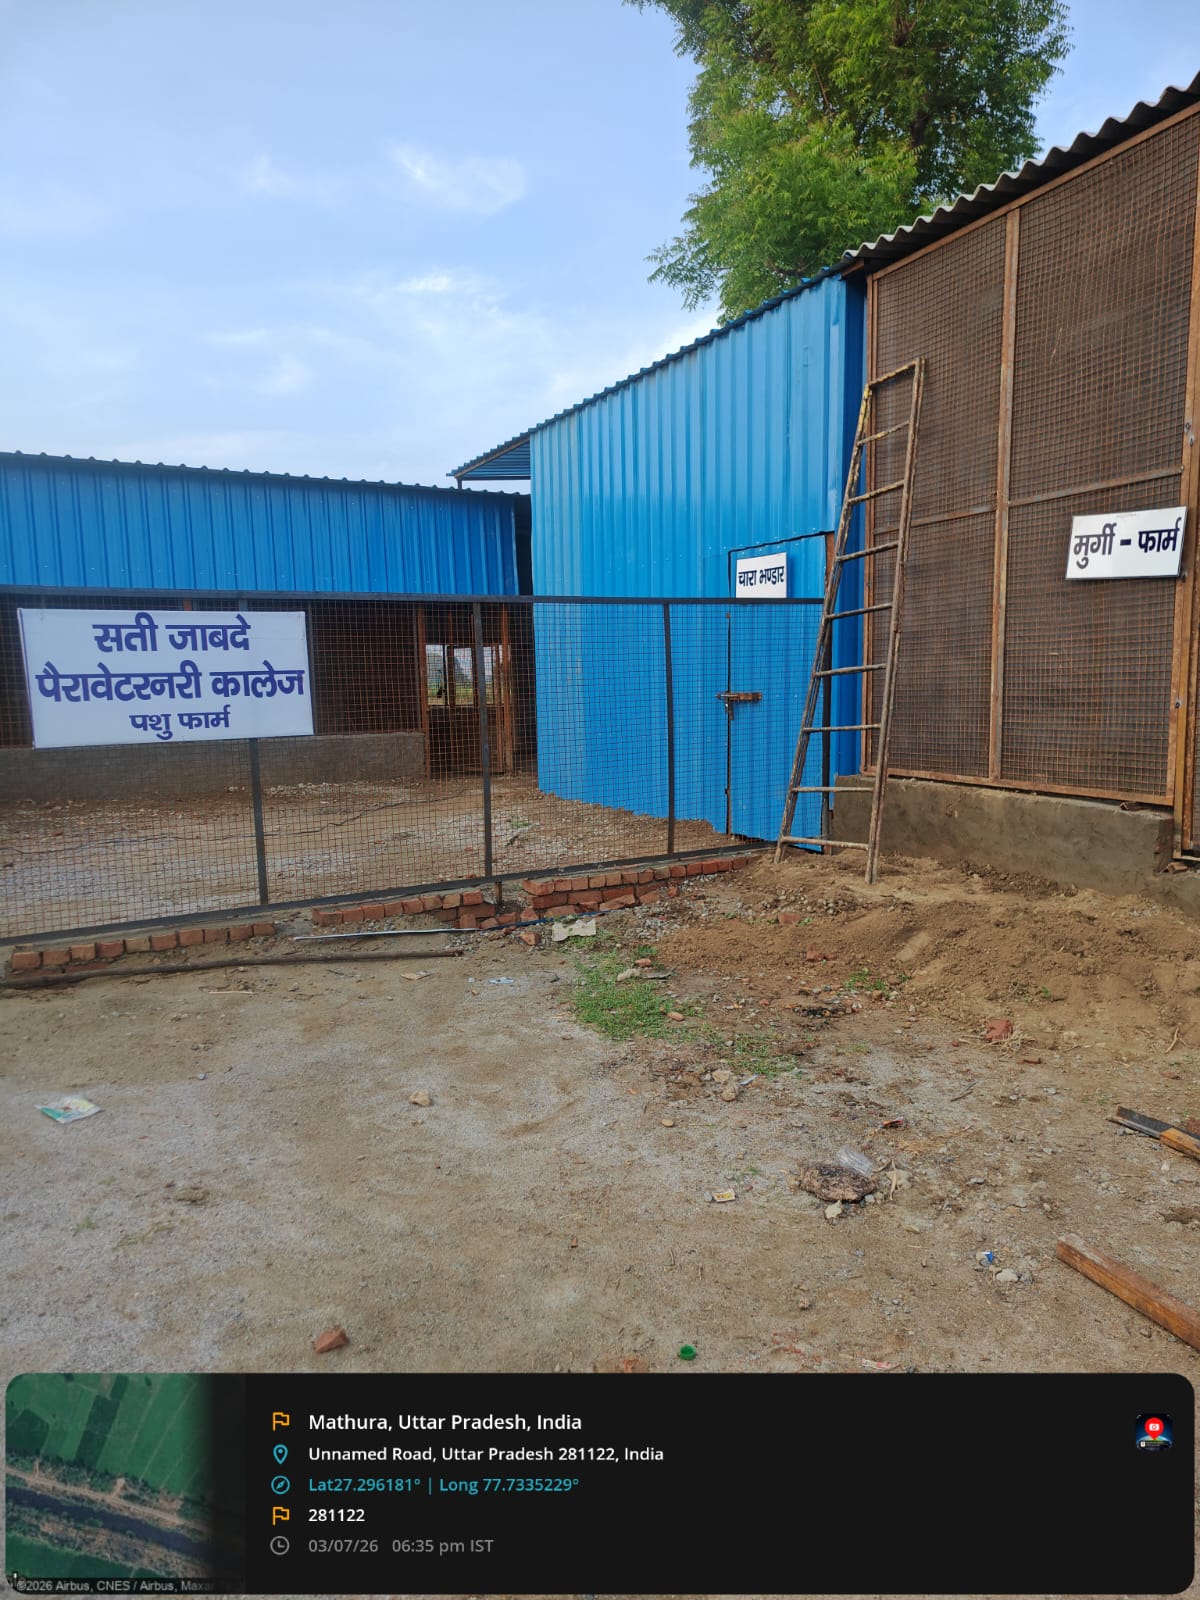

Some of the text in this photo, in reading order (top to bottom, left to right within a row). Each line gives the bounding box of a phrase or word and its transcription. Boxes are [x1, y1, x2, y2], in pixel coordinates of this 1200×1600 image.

[1073, 522, 1117, 569] मुर्गी
[1138, 516, 1182, 553] फार्म
[738, 566, 785, 587] चारा भण्डार
[92, 612, 251, 652] सती जाबदे
[35, 659, 305, 702] पैरावेटरनरी कालेज
[129, 704, 231, 740] पशु फार्म
